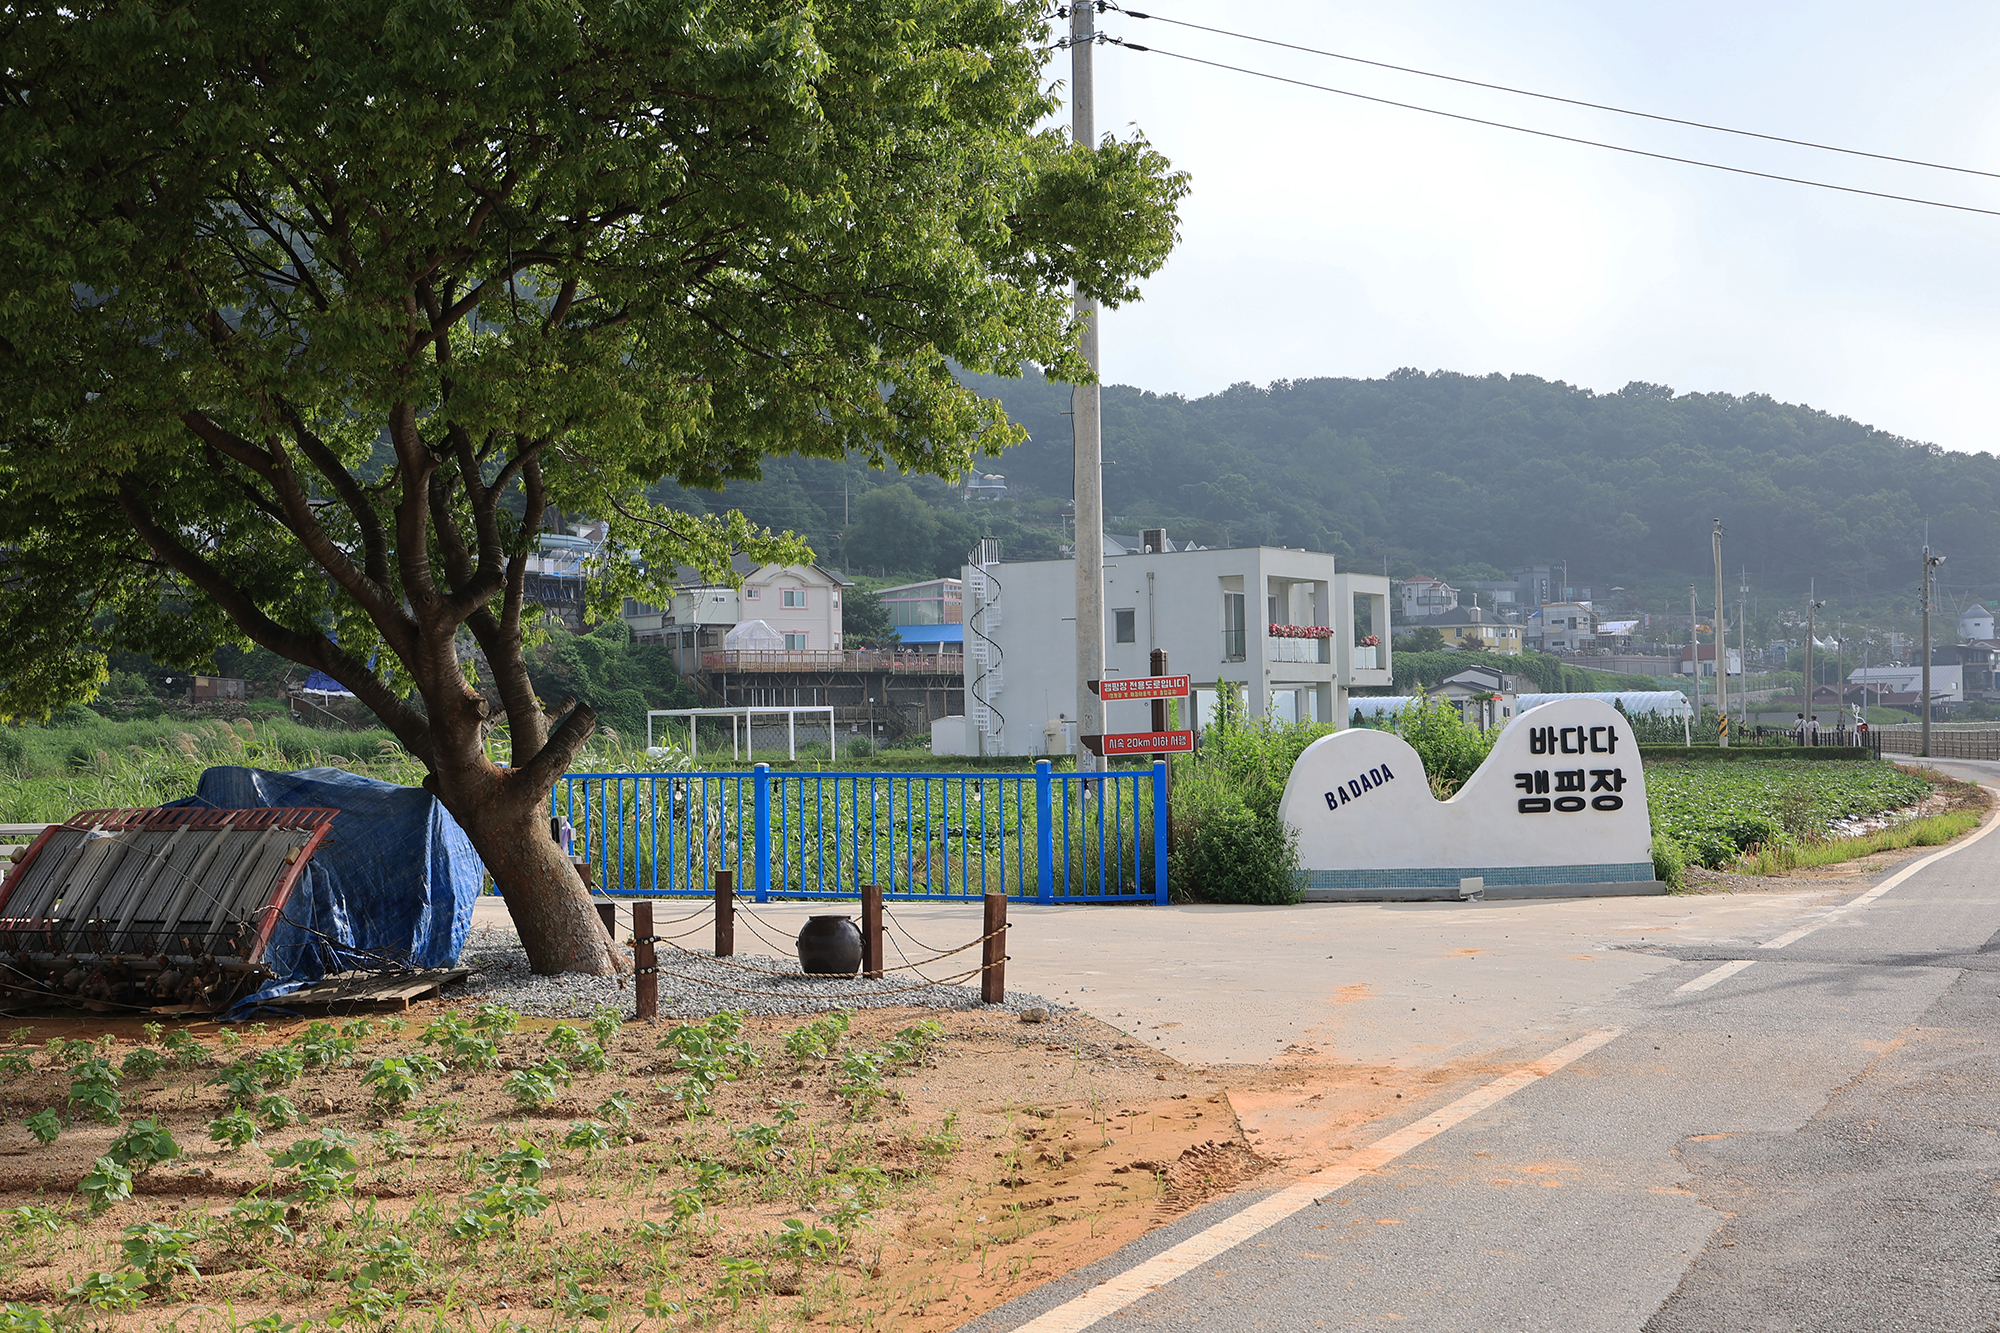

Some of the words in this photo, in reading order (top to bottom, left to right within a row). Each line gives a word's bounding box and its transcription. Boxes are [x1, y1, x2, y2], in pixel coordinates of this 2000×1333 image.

[1104, 681, 1127, 692] 캠핑장
[1130, 679, 1185, 690] 전용도로입니다
[1109, 739, 1125, 748] 시속
[1127, 738, 1150, 748] 20km
[1152, 736, 1168, 747] 이하
[1171, 735, 1186, 746] 서행
[1530, 726, 1619, 755] 바다다
[1324, 763, 1395, 811] BADADA
[1514, 768, 1627, 813] 캠핑장
